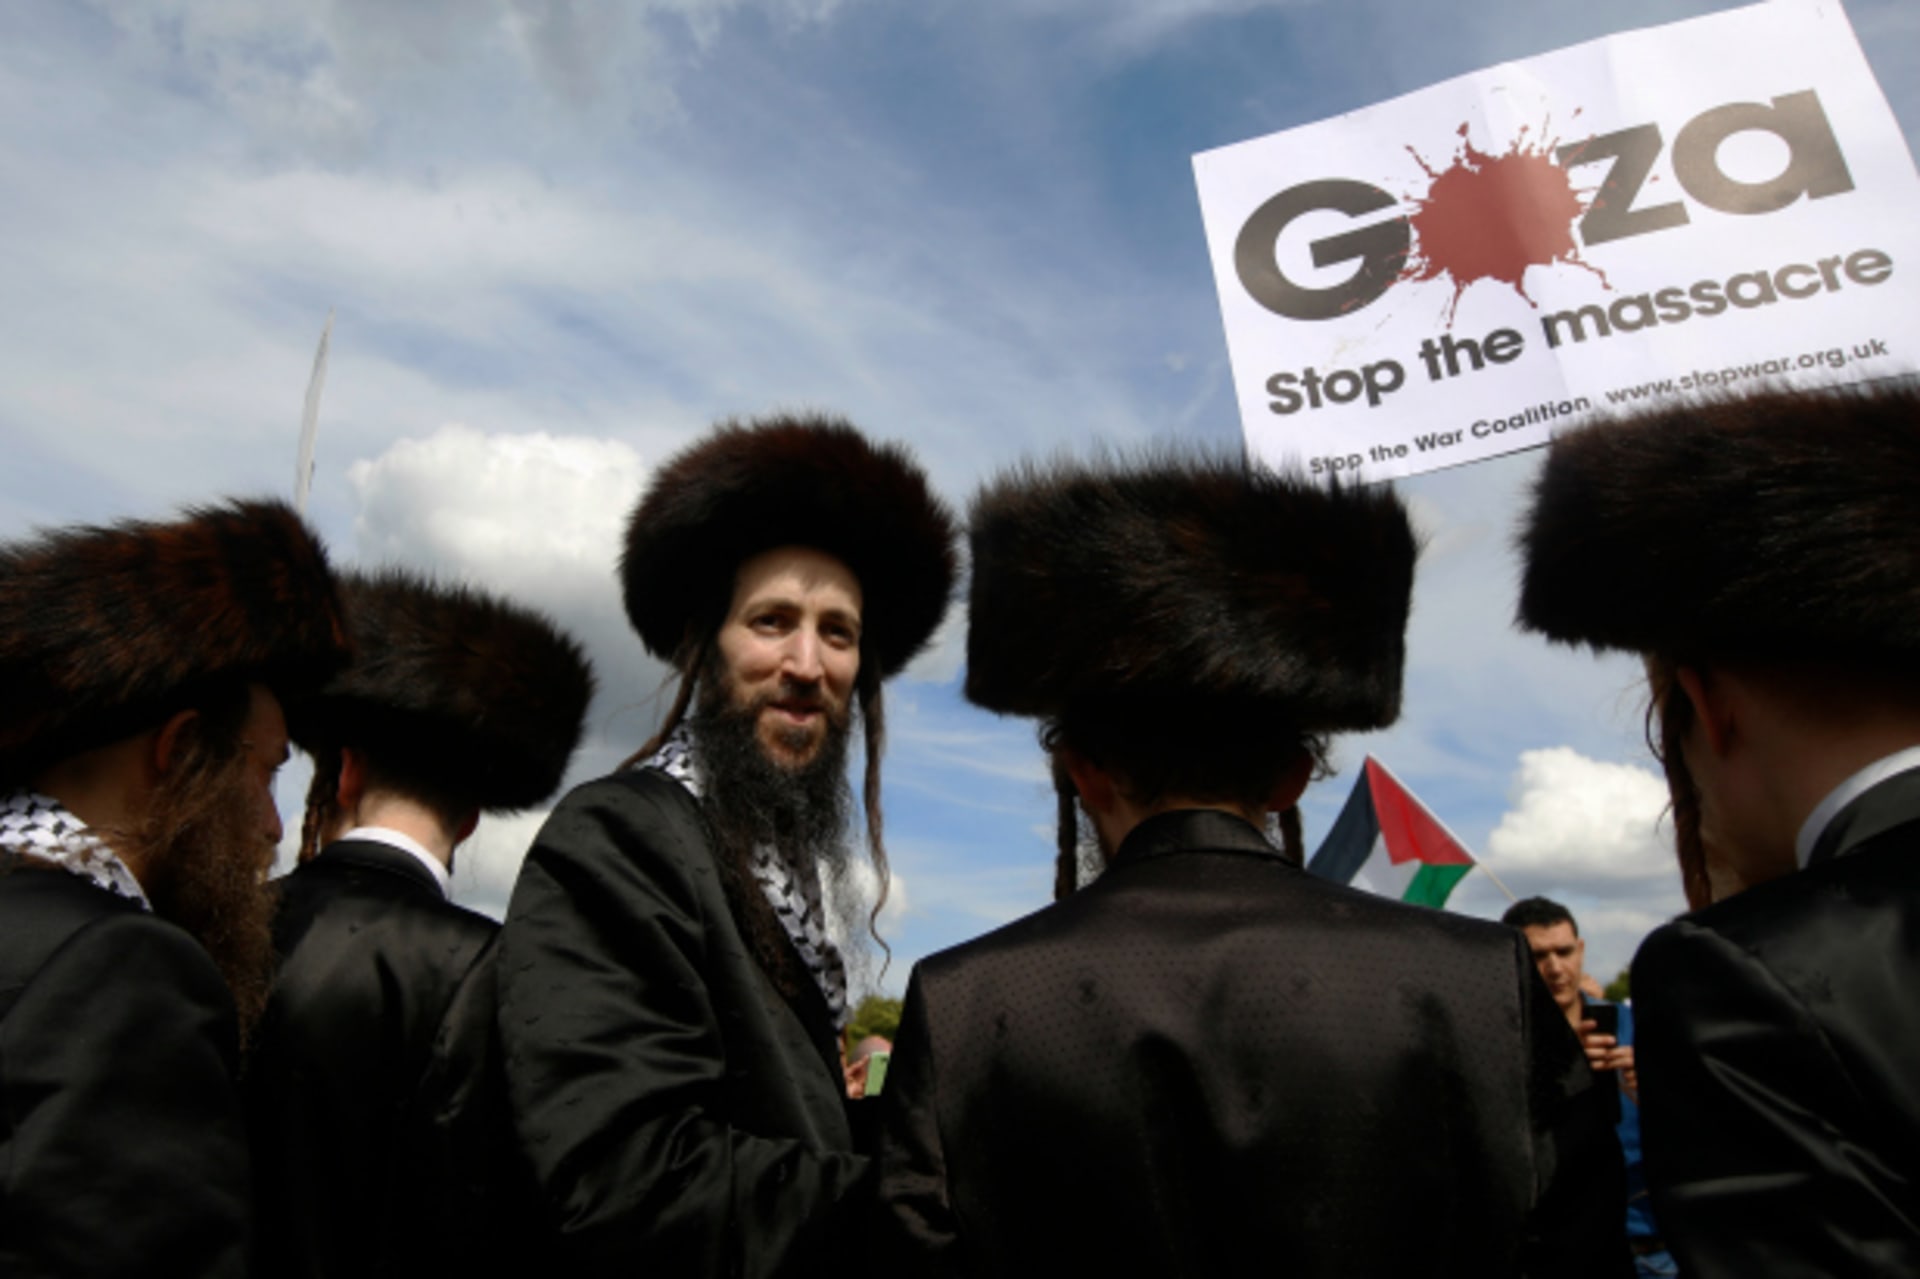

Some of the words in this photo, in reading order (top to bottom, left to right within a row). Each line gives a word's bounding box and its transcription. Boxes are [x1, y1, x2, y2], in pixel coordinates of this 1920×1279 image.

[1234, 88, 1856, 320] Gza
[1265, 359, 1405, 415] Stop
[1418, 333, 1525, 381] the
[1541, 249, 1894, 349] massacre
[1309, 452, 1364, 475] Stop
[1369, 443, 1409, 463] the
[1414, 428, 1463, 453] War
[1471, 395, 1591, 439] Coalition
[1605, 338, 1889, 404] www.stopwar.org.uk
